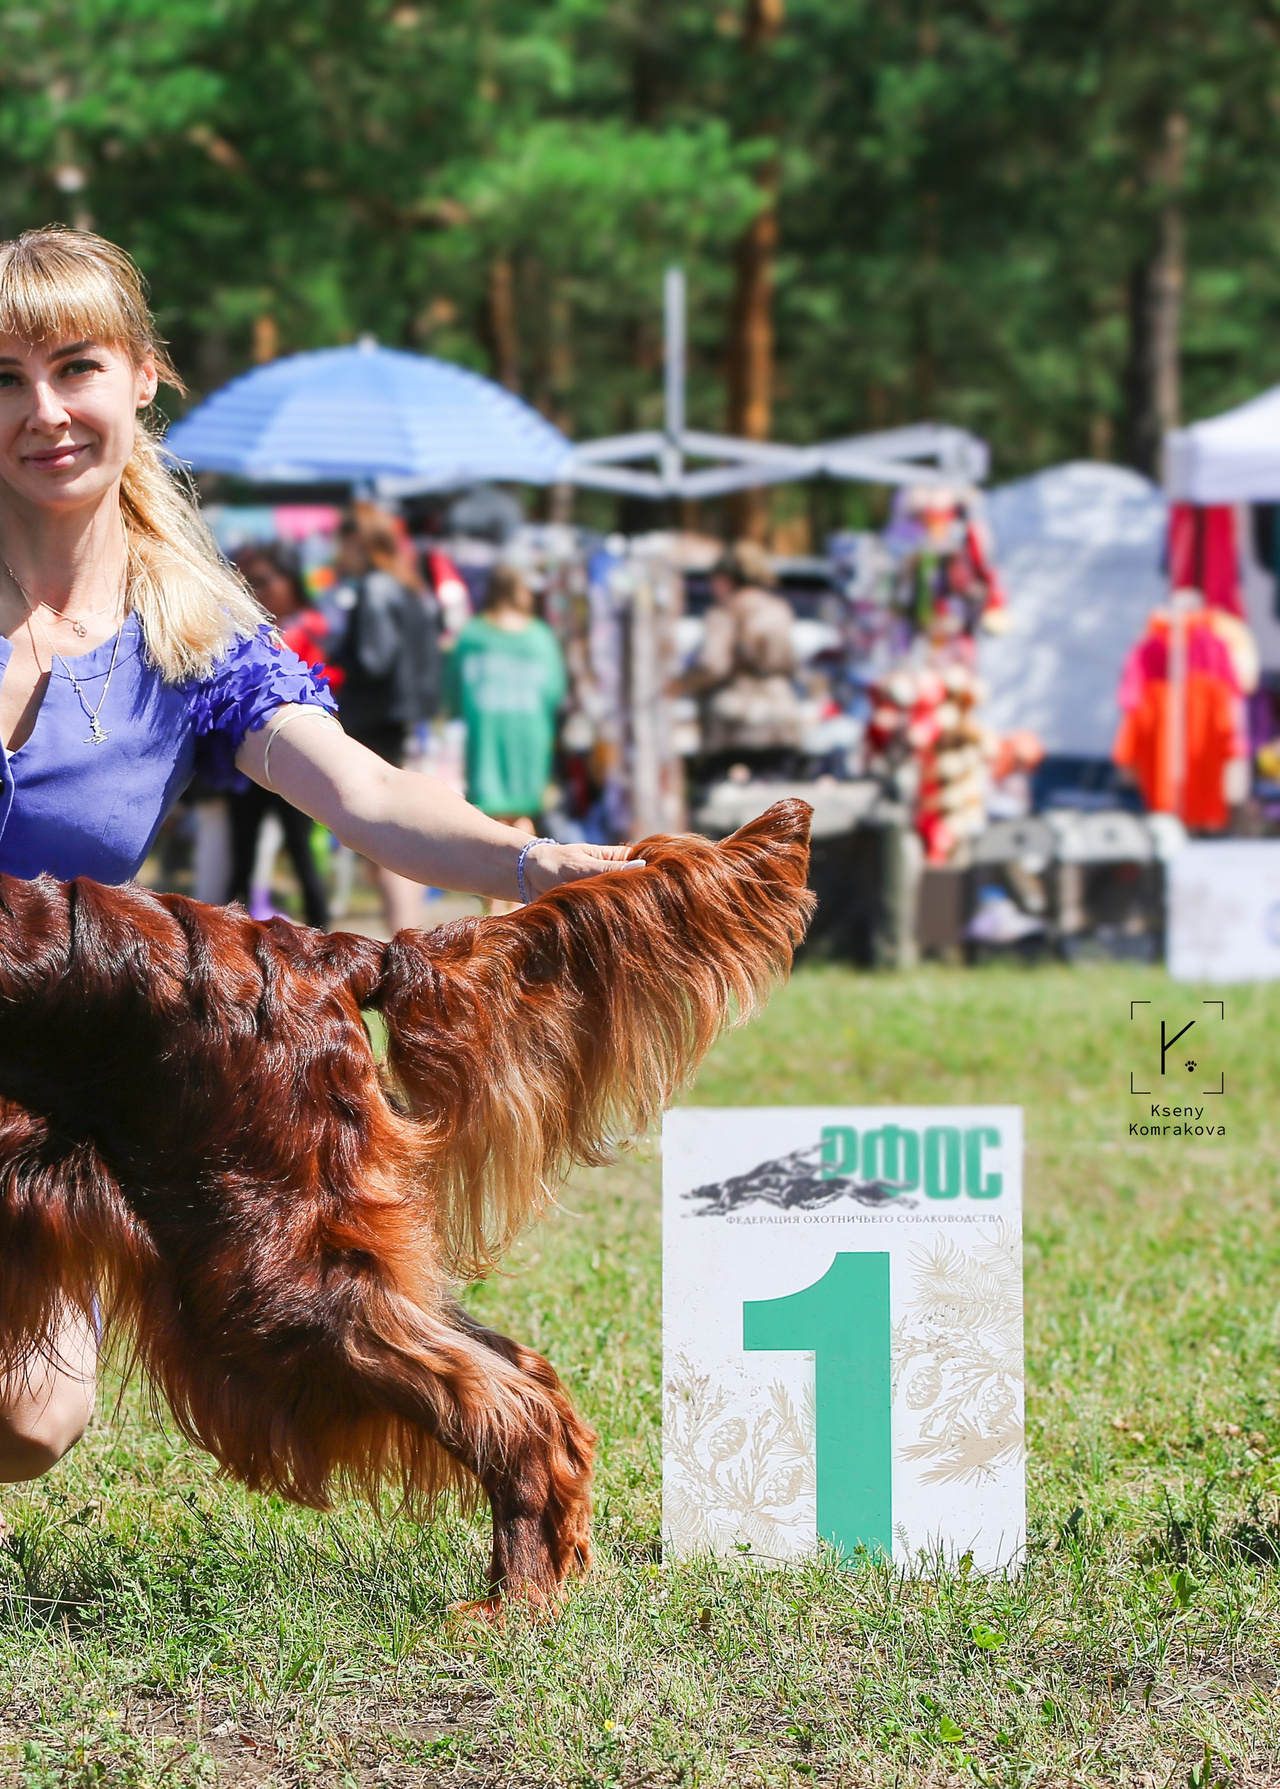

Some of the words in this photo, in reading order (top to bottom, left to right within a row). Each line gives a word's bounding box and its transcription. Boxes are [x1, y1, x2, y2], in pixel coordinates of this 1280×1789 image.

[821, 1124, 1003, 1200] РФОС
[726, 1215, 800, 1225] ФЕДЕРАЦИЯ
[803, 1214, 894, 1224] ОХОТНИЧЬЕГО
[897, 1214, 1003, 1224] СОБАКОВОДСТВА
[743, 1252, 891, 1570] 1
